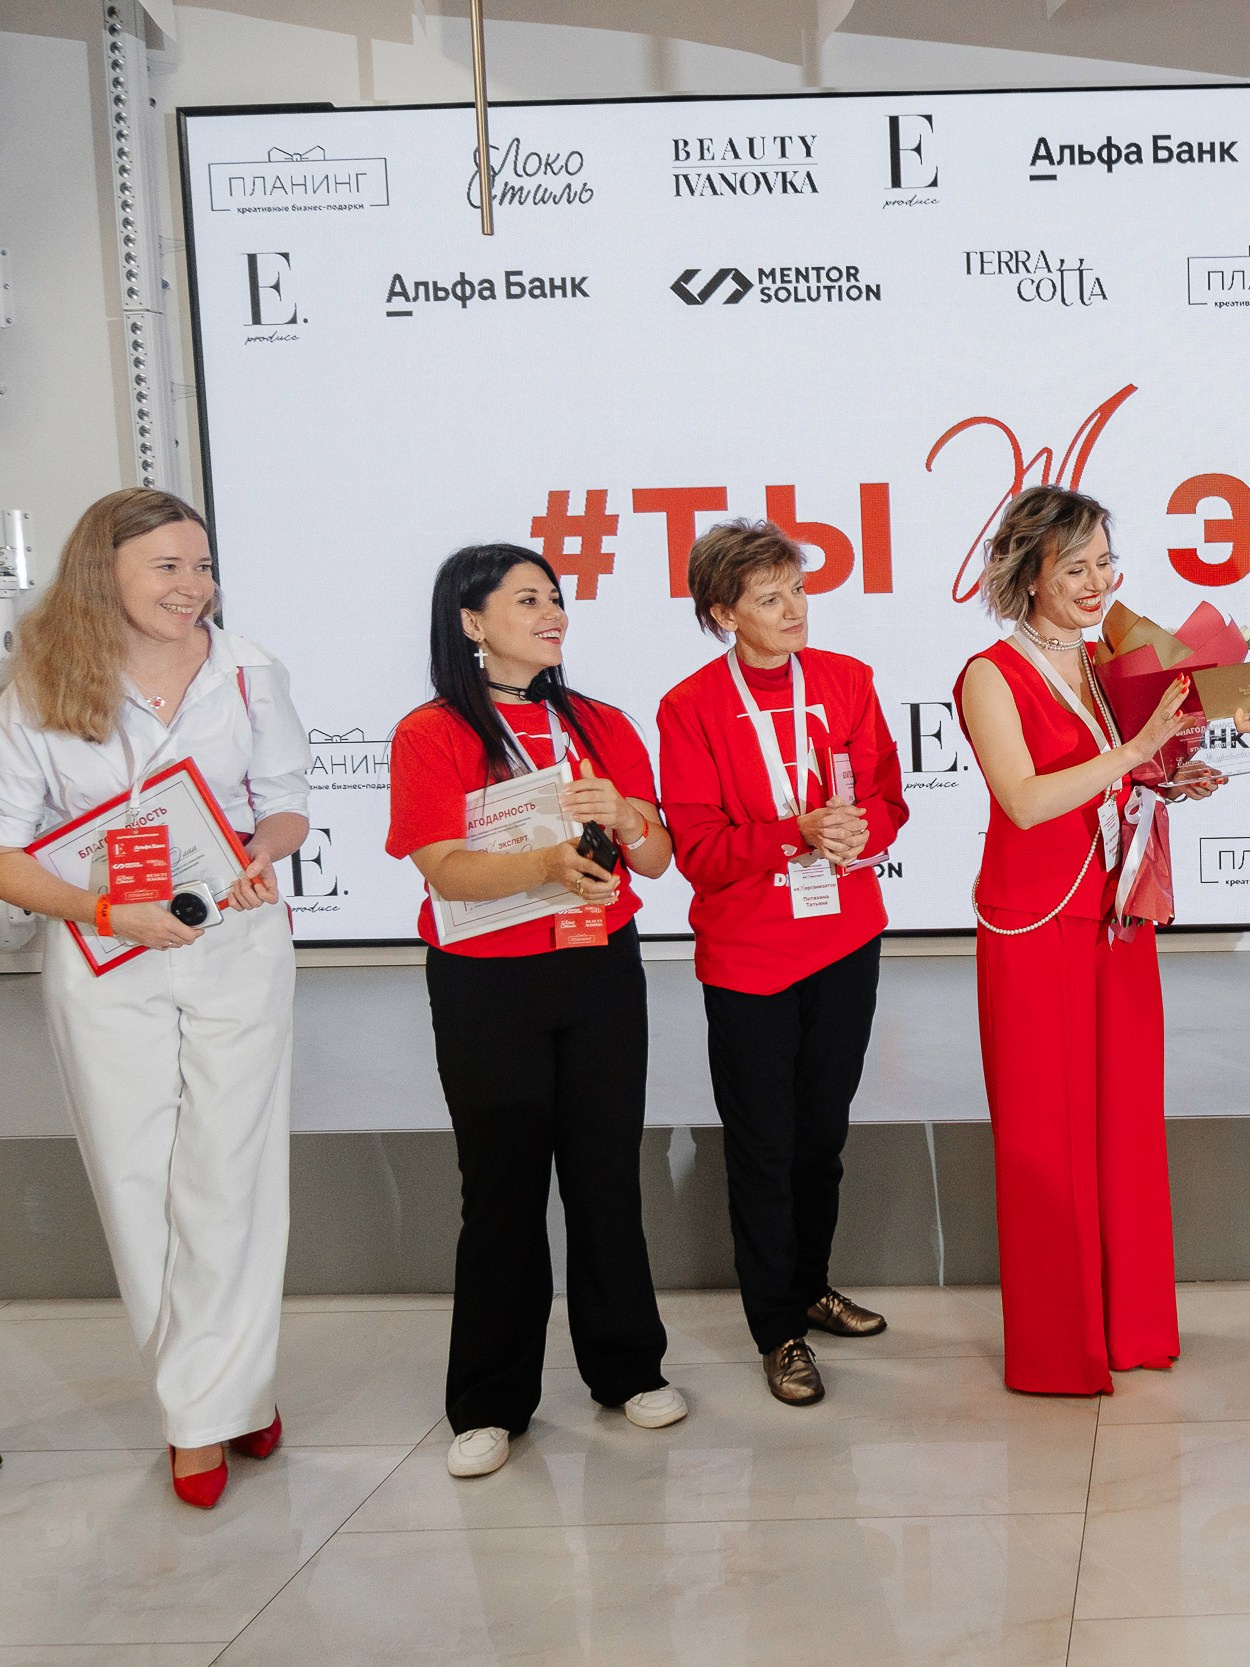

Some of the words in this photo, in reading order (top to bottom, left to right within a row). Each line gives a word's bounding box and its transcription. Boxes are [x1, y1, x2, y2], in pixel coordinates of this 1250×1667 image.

[672, 135, 817, 161] BEAUTY
[885, 114, 938, 189] E
[1030, 136, 1143, 173] Альфа
[1152, 135, 1238, 164] Банк
[229, 173, 367, 197] ПЛАНИНГ
[672, 167, 819, 197] IVANOVKA
[883, 195, 939, 209] produce
[963, 250, 1053, 275] TERRA
[242, 252, 308, 326] E.
[386, 272, 496, 308] Альфа
[504, 270, 590, 300] Банк
[758, 266, 860, 287] MENTOR
[759, 283, 881, 303] SOLUTION
[245, 331, 299, 345] produce
[530, 482, 894, 600] #ТЫ
[900, 698, 970, 774] E.
[1176, 722, 1233, 737] ЛАГОДАРНОС
[304, 752, 390, 775] АНИН
[331, 780, 390, 791] бизнес-подар
[904, 778, 959, 792] produce
[467, 802, 536, 830] АГОДАРНОСТЬ
[78, 807, 167, 859] БЛАГНОСТЬ
[499, 835, 528, 849] ЭКСПЕРТ
